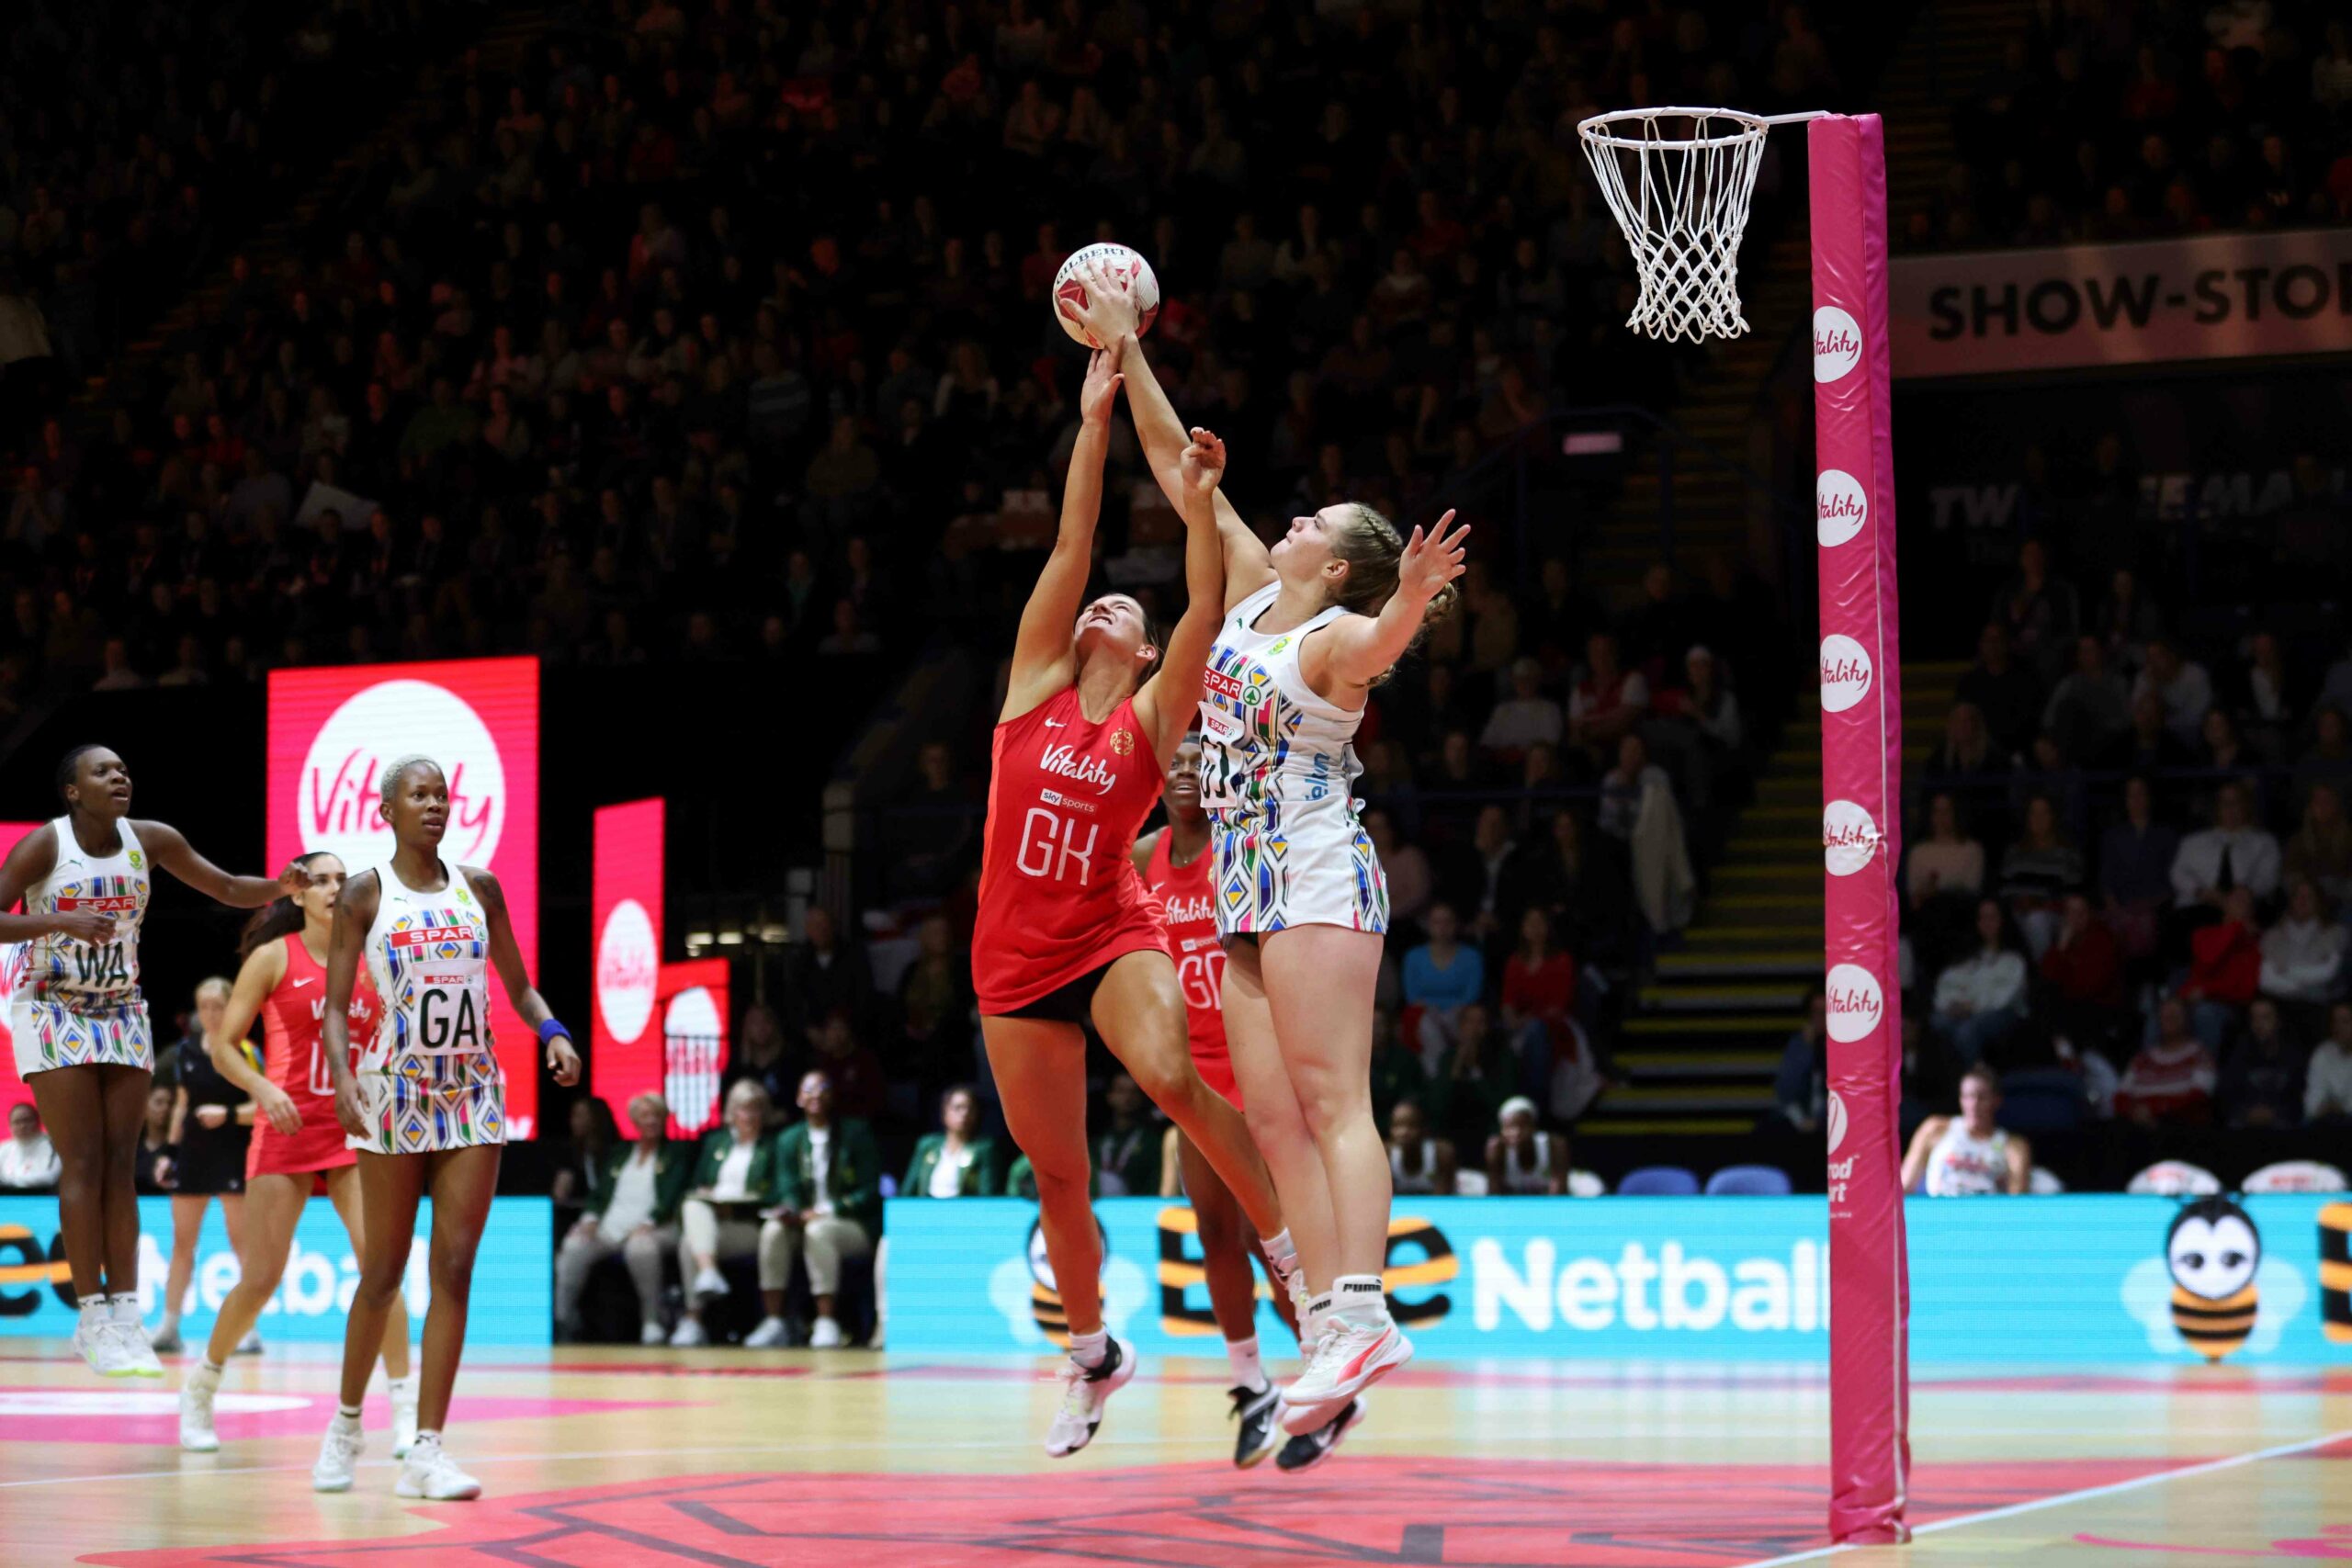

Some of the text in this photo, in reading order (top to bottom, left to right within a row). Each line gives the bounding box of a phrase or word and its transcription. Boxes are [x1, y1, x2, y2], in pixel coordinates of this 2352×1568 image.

[1056, 247, 1127, 286] GILBERT
[1815, 327, 1860, 362] tality
[1818, 491, 1864, 526] tality
[1204, 670, 1241, 697] SPAR
[1210, 719, 1228, 736] SPAR
[1039, 742, 1117, 796] Vitality
[312, 747, 493, 862] Vitaty
[1043, 790, 1096, 814] sky sports
[1015, 807, 1100, 886] GK
[409, 926, 473, 943] SPAR
[74, 940, 129, 988] WA
[433, 976, 465, 985] SPAR
[419, 987, 479, 1049] GA
